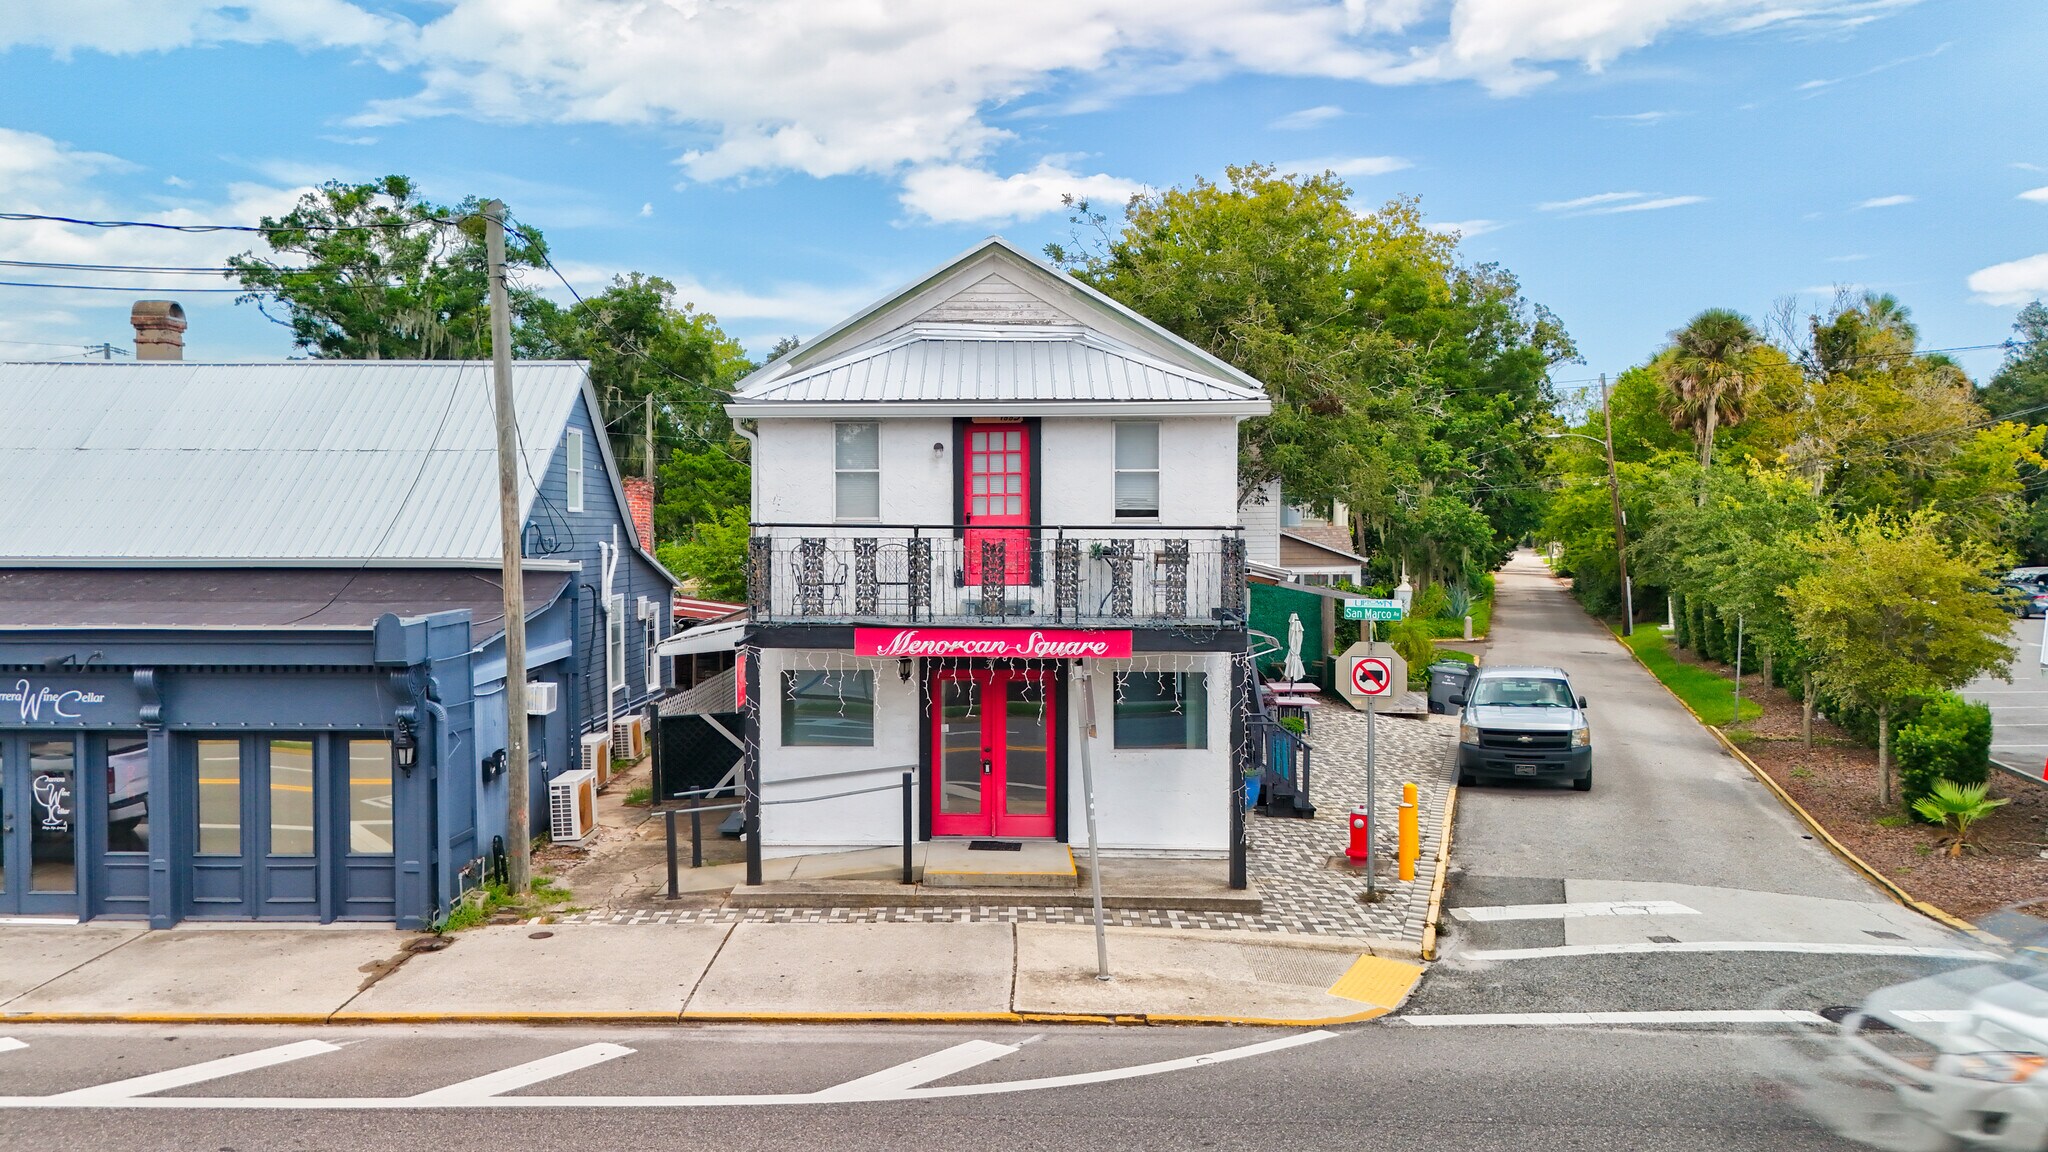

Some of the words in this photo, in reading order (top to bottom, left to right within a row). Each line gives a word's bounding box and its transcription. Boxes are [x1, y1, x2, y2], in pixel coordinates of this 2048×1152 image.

[1345, 608, 1363, 618] San
[1364, 608, 1392, 619] Marco
[876, 630, 1010, 656] Menorcan
[1016, 630, 1109, 657] Square
[16, 679, 59, 720] Wine
[55, 690, 105, 717] Cellar
